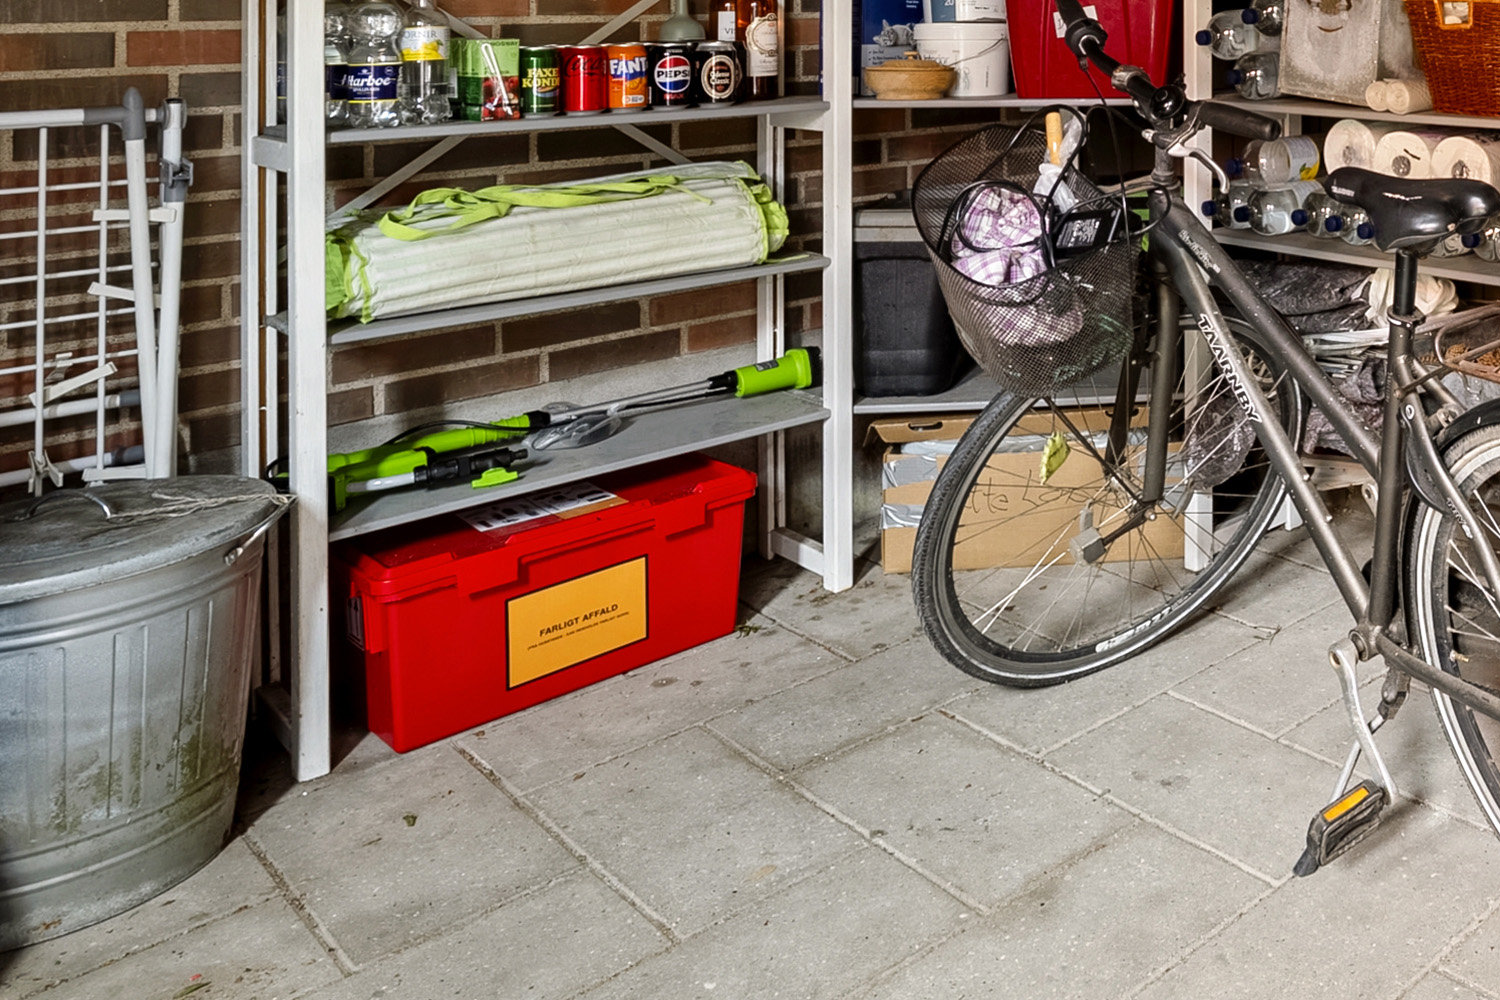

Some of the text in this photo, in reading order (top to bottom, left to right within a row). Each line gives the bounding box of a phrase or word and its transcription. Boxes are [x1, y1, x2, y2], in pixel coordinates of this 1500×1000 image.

[527, 67, 558, 78] FAXE
[347, 74, 392, 87] Harboe
[539, 616, 580, 638] FARLIGT
[581, 603, 619, 622] AFFALD
